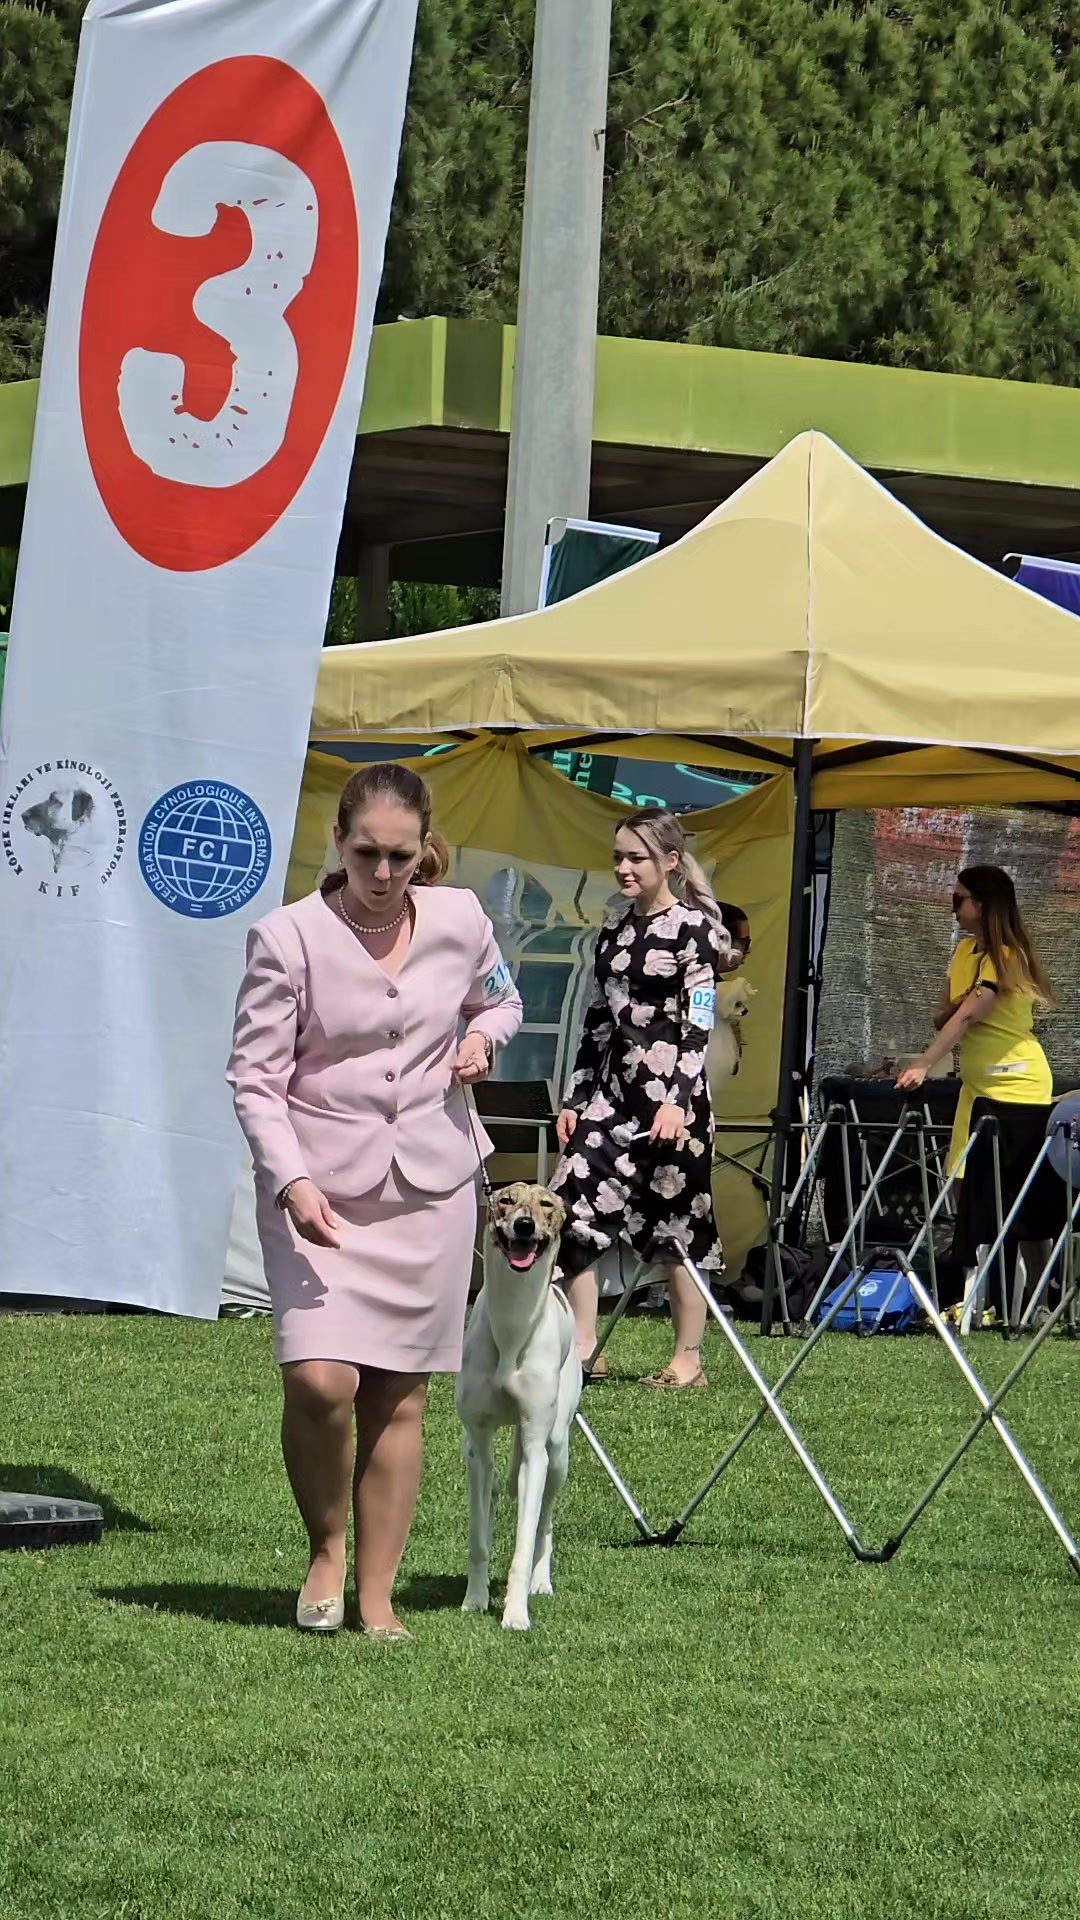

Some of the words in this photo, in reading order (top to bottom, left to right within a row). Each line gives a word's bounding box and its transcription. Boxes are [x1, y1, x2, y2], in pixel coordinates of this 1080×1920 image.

[118, 140, 319, 488] 3
[2, 773, 34, 825] IRKLARI
[35, 762, 52, 776] VE
[100, 791, 127, 885] FEDERASYONU
[154, 784, 248, 820] CYNOLOGIQUE
[142, 821, 179, 904] FEDERATION
[182, 837, 228, 862] FCI
[216, 807, 267, 912] INTERNATIONALE
